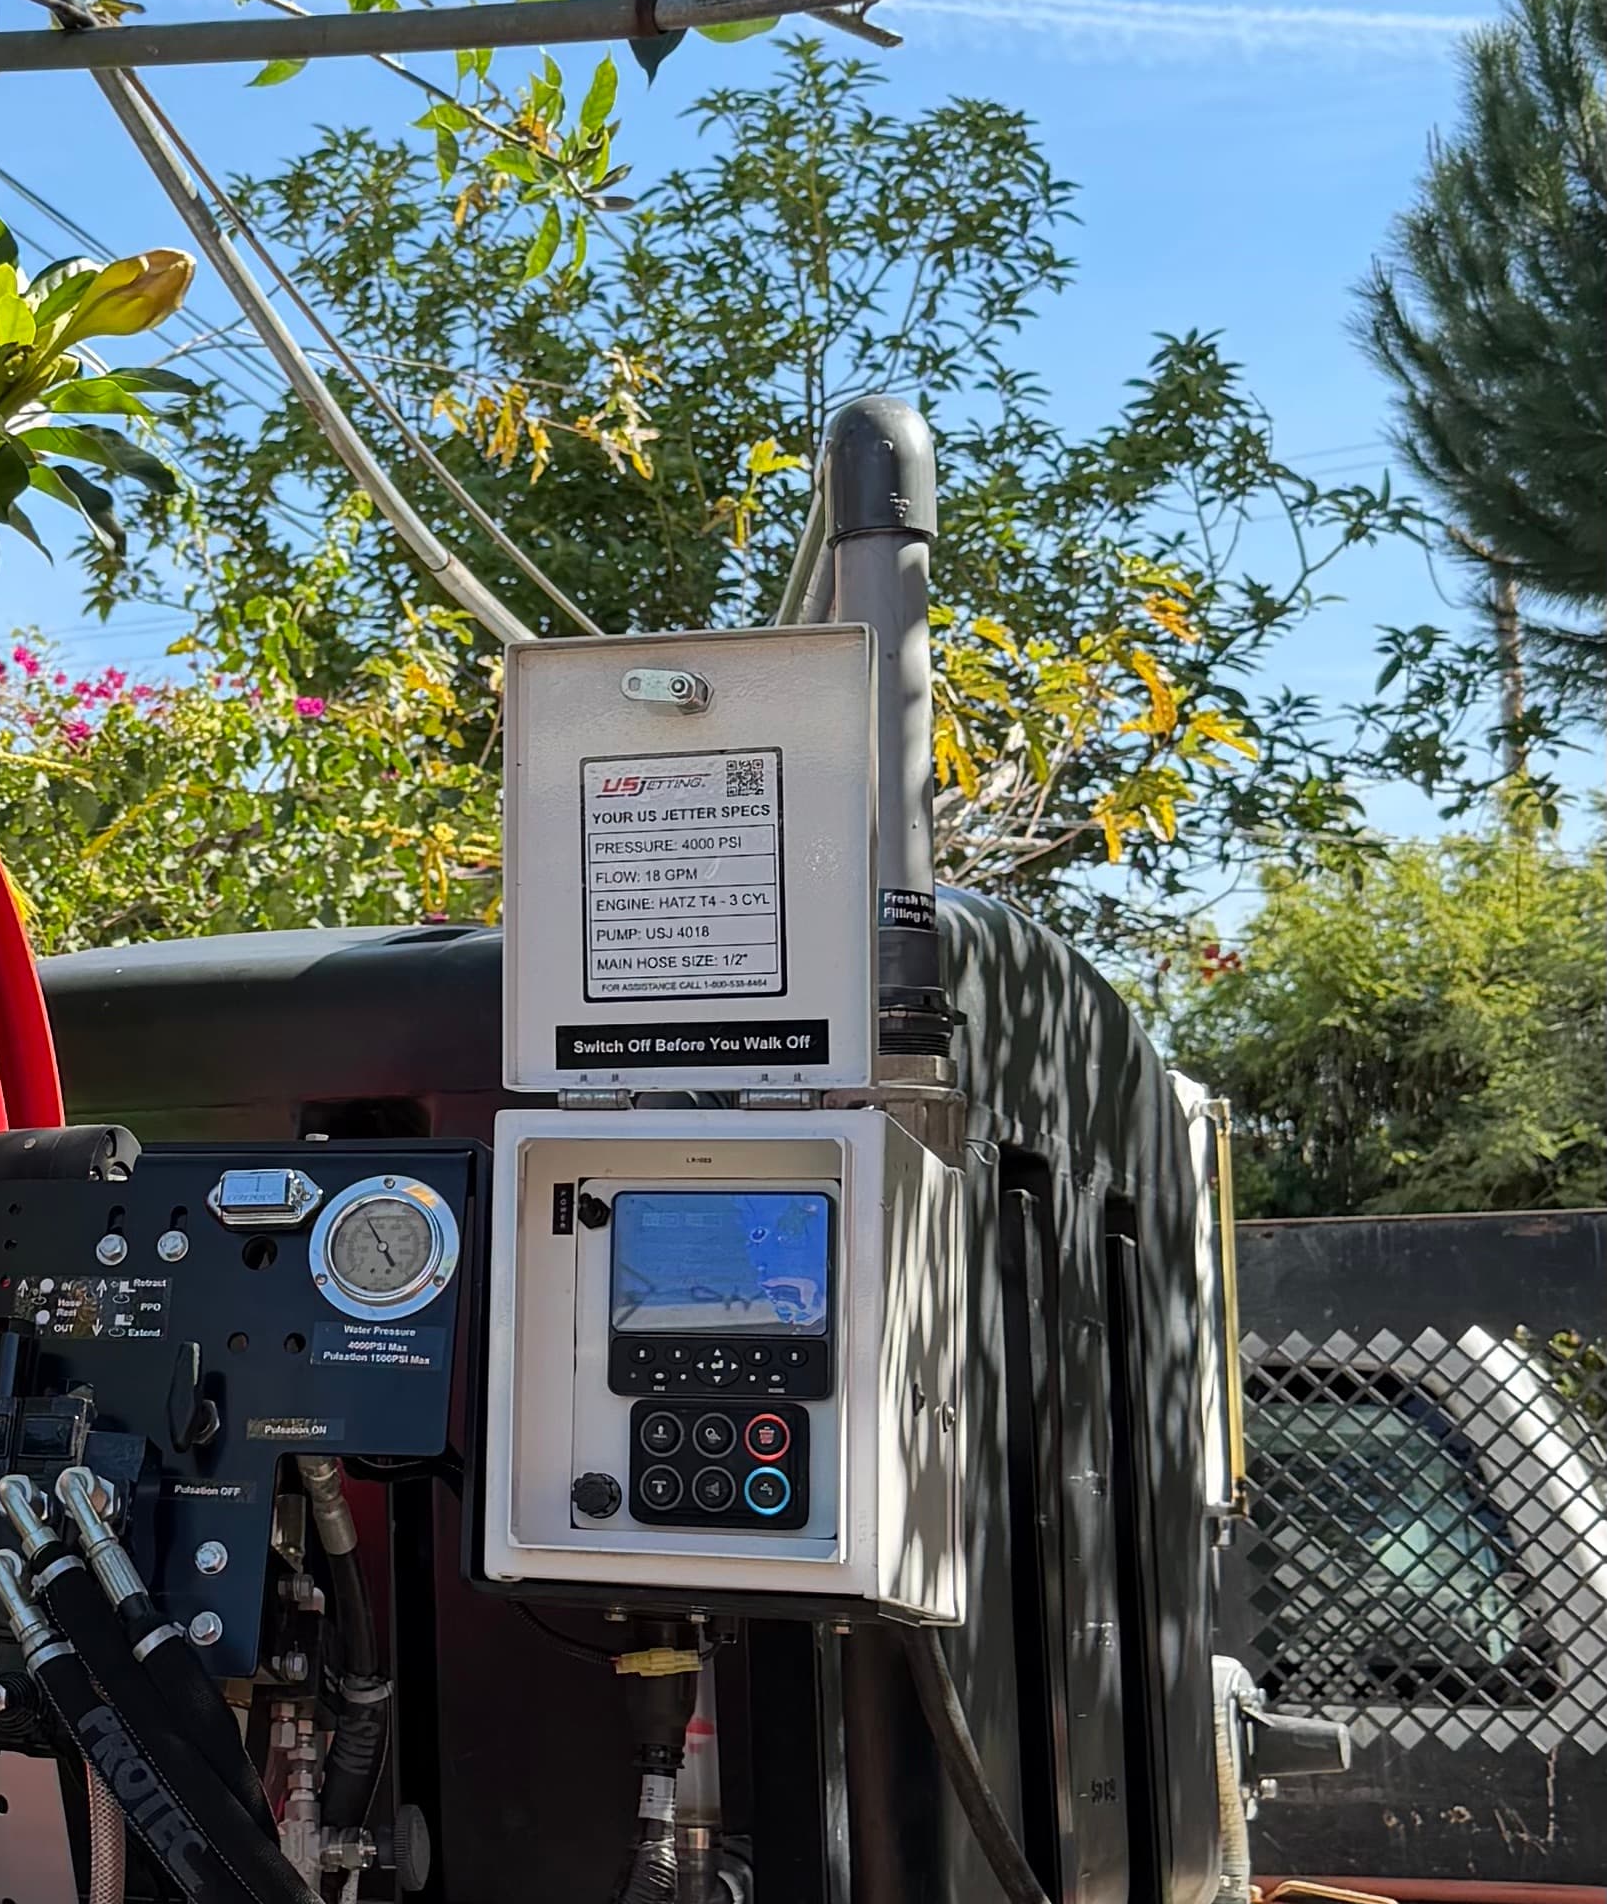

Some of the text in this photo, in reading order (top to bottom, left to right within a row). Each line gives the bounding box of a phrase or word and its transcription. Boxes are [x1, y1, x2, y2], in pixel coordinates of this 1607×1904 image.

[593, 804, 770, 824] YOUR US JETTER SPECS
[595, 836, 741, 854] PRESSURE: 4000 PSI
[596, 868, 697, 884] FLOW: 18 GPM
[596, 898, 654, 911] ENGINE:
[659, 896, 696, 909] HATZ
[699, 895, 716, 907] T4
[729, 894, 738, 906] 3
[741, 893, 770, 905] CYL
[884, 892, 918, 905] Fresh
[884, 907, 921, 923] Filling
[596, 925, 710, 942] PUMP: USJ 4018
[597, 958, 632, 971] MAIN
[637, 956, 677, 969] HOSE
[682, 954, 717, 967] SIZE:
[602, 984, 619, 992] FOR
[621, 982, 676, 992] ASSISTANCE
[679, 981, 701, 990] CALL
[574, 1035, 811, 1053] Switch Off Before You Walk Off
[133, 1279, 167, 1288] Retract
[54, 1324, 74, 1333] OUT
[128, 1328, 161, 1337] Extend
[344, 1325, 416, 1336] Water Pressure
[388, 1343, 408, 1352] Max
[323, 1351, 368, 1362] Pulsation
[410, 1355, 430, 1365] Max
[264, 1425, 327, 1435] Pulsation ON
[174, 1484, 241, 1496] Pulsation OFF
[78, 1705, 207, 1894] PROTEC
